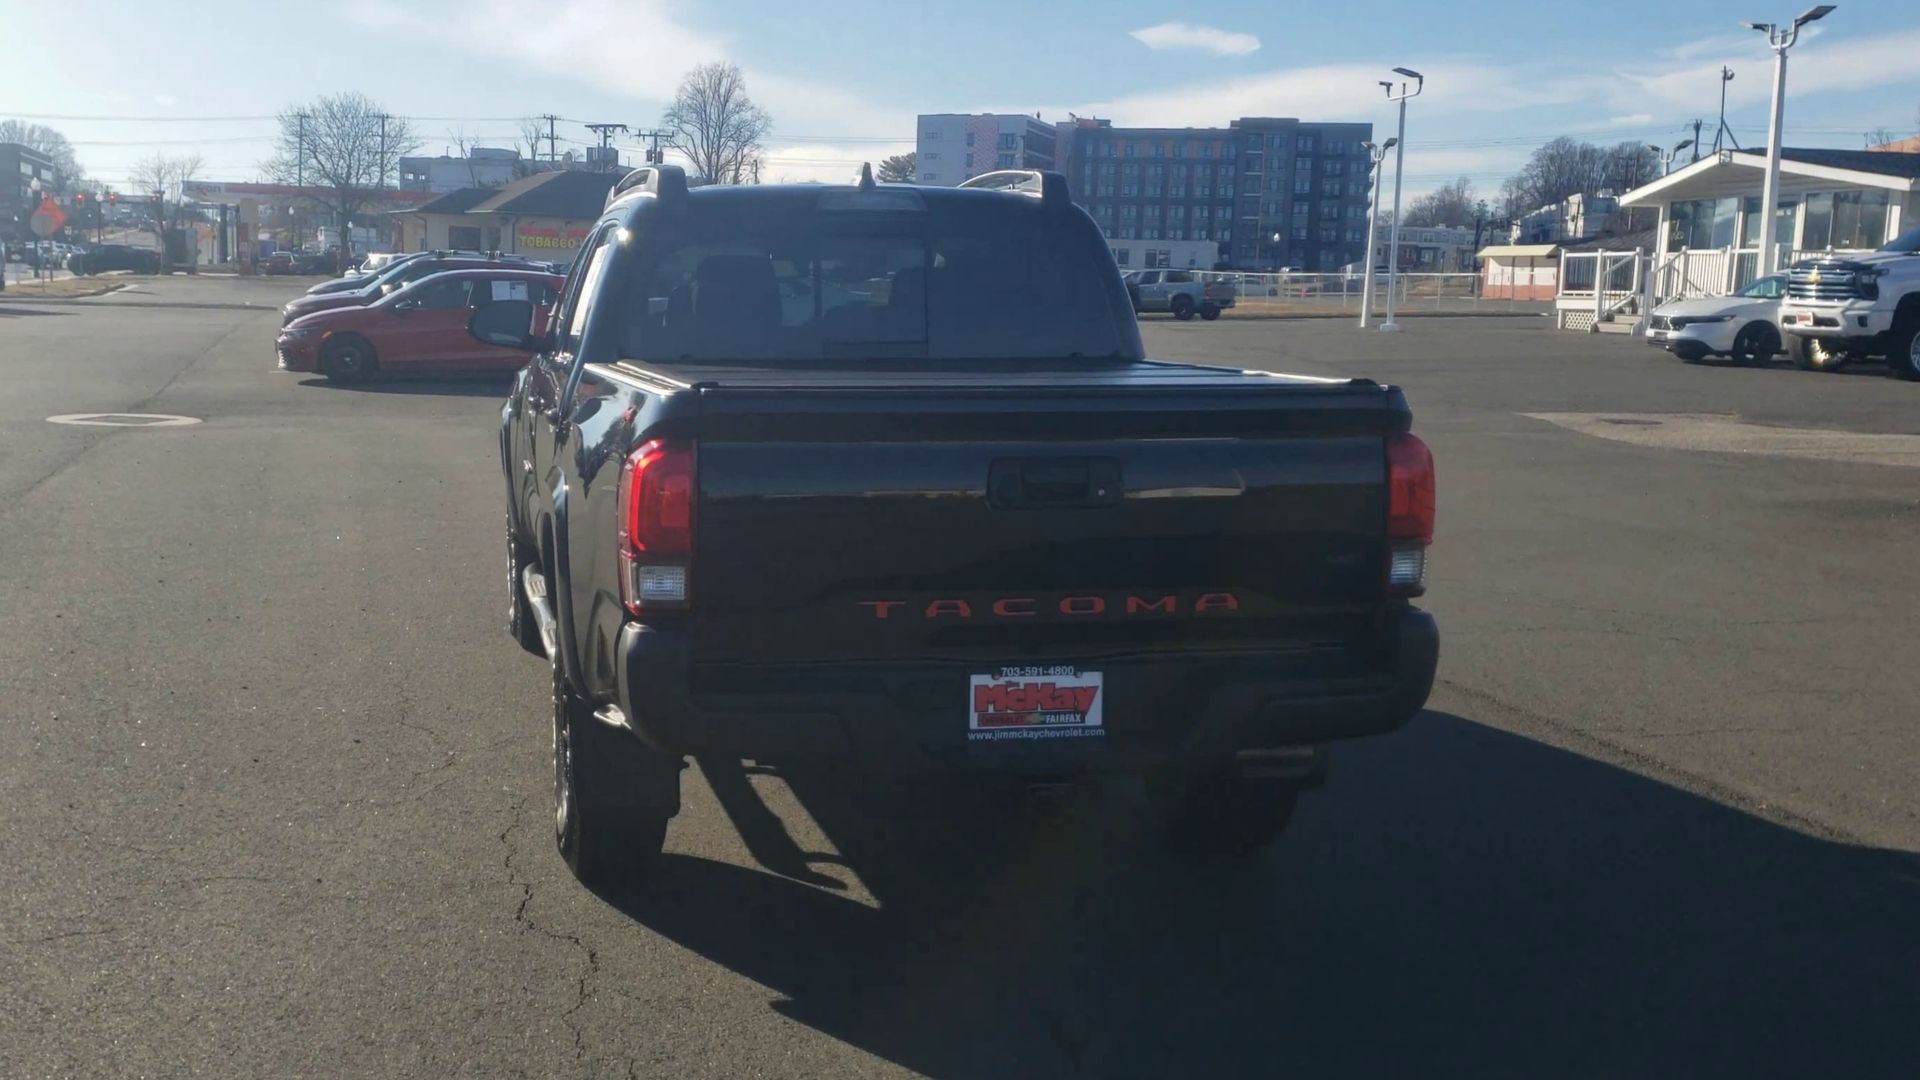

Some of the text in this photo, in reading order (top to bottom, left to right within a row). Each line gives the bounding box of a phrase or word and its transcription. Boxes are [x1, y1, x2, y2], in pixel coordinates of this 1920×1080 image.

[519, 236, 576, 249] TOBACCO
[856, 593, 1239, 618] TACOMA
[1001, 666, 1074, 677] 703-591-4800
[974, 682, 1099, 714] McKay
[1046, 713, 1081, 724] FAIRFAX
[968, 728, 1105, 741] www.jimmckaychevrolet.com
